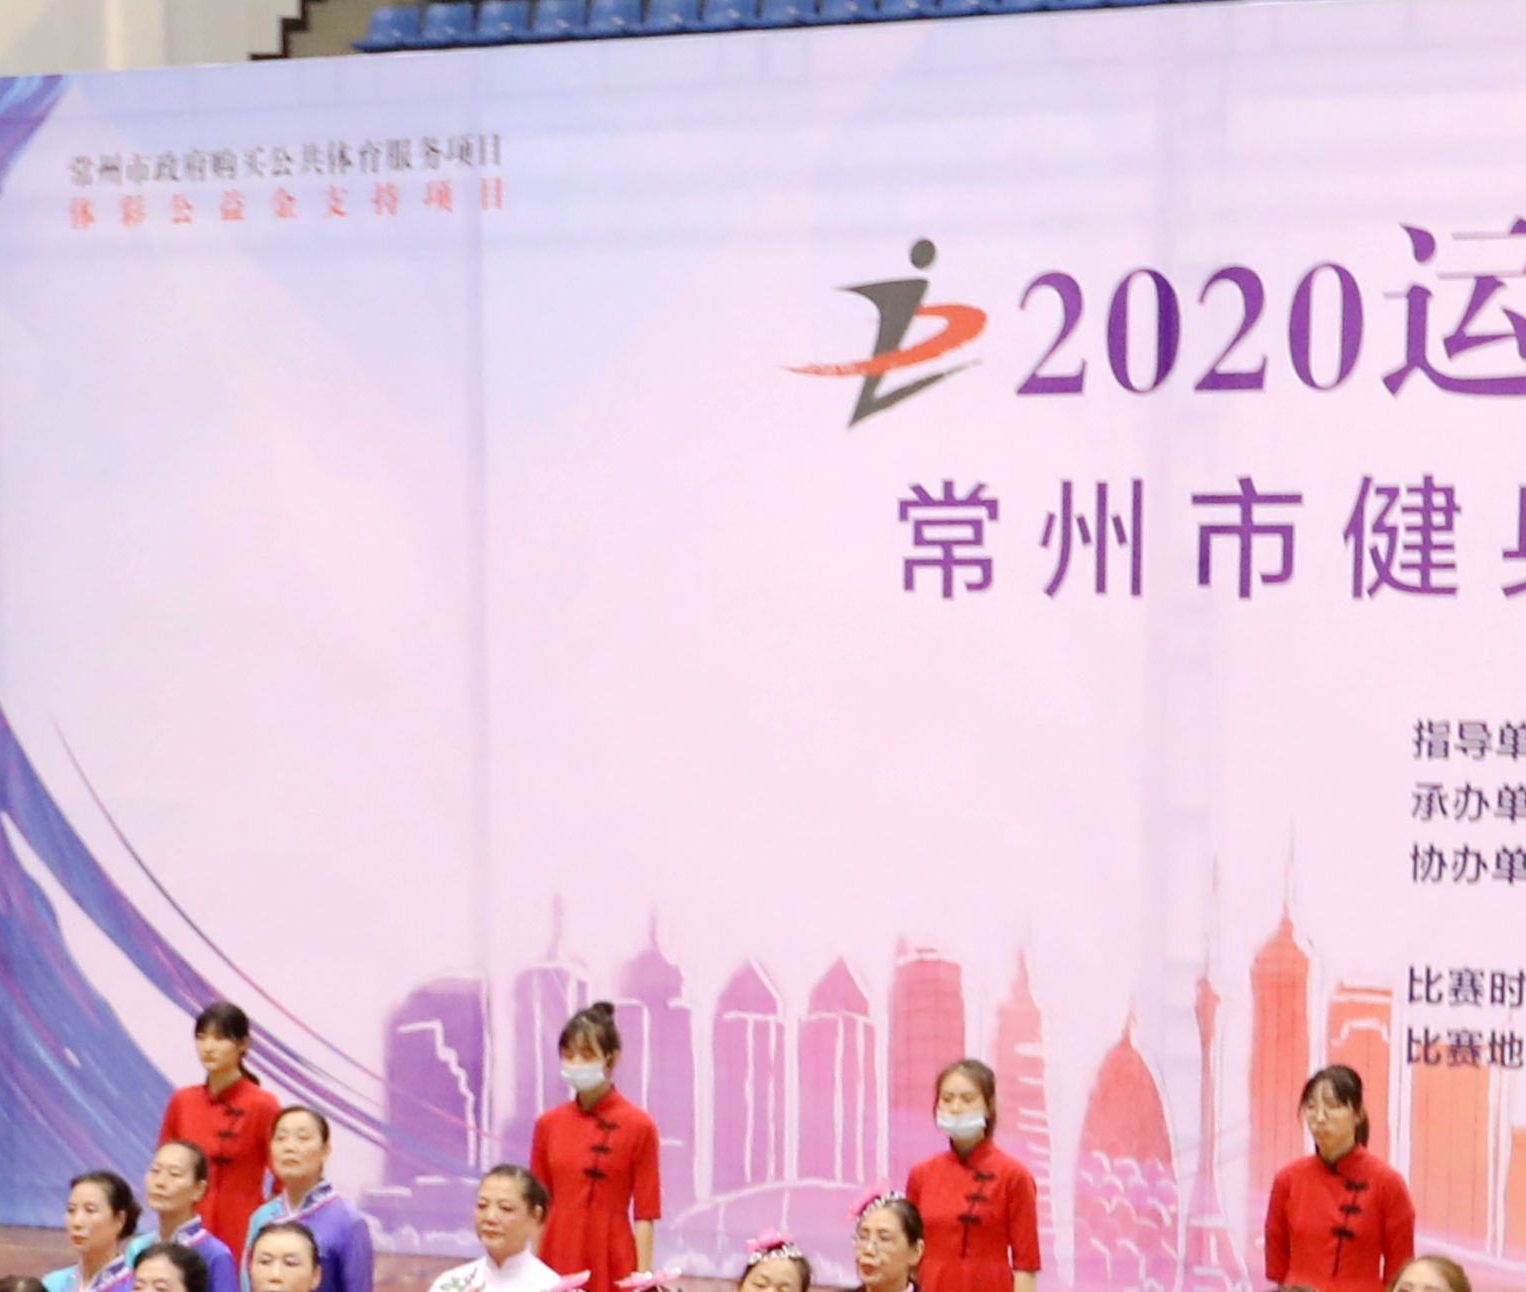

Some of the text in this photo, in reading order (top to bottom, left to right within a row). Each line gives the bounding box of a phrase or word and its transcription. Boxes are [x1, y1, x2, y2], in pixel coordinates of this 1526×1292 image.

[67, 133, 503, 188] 常州市政府购买公共体育服务项目
[68, 177, 506, 230] 体彩公益金支持项目
